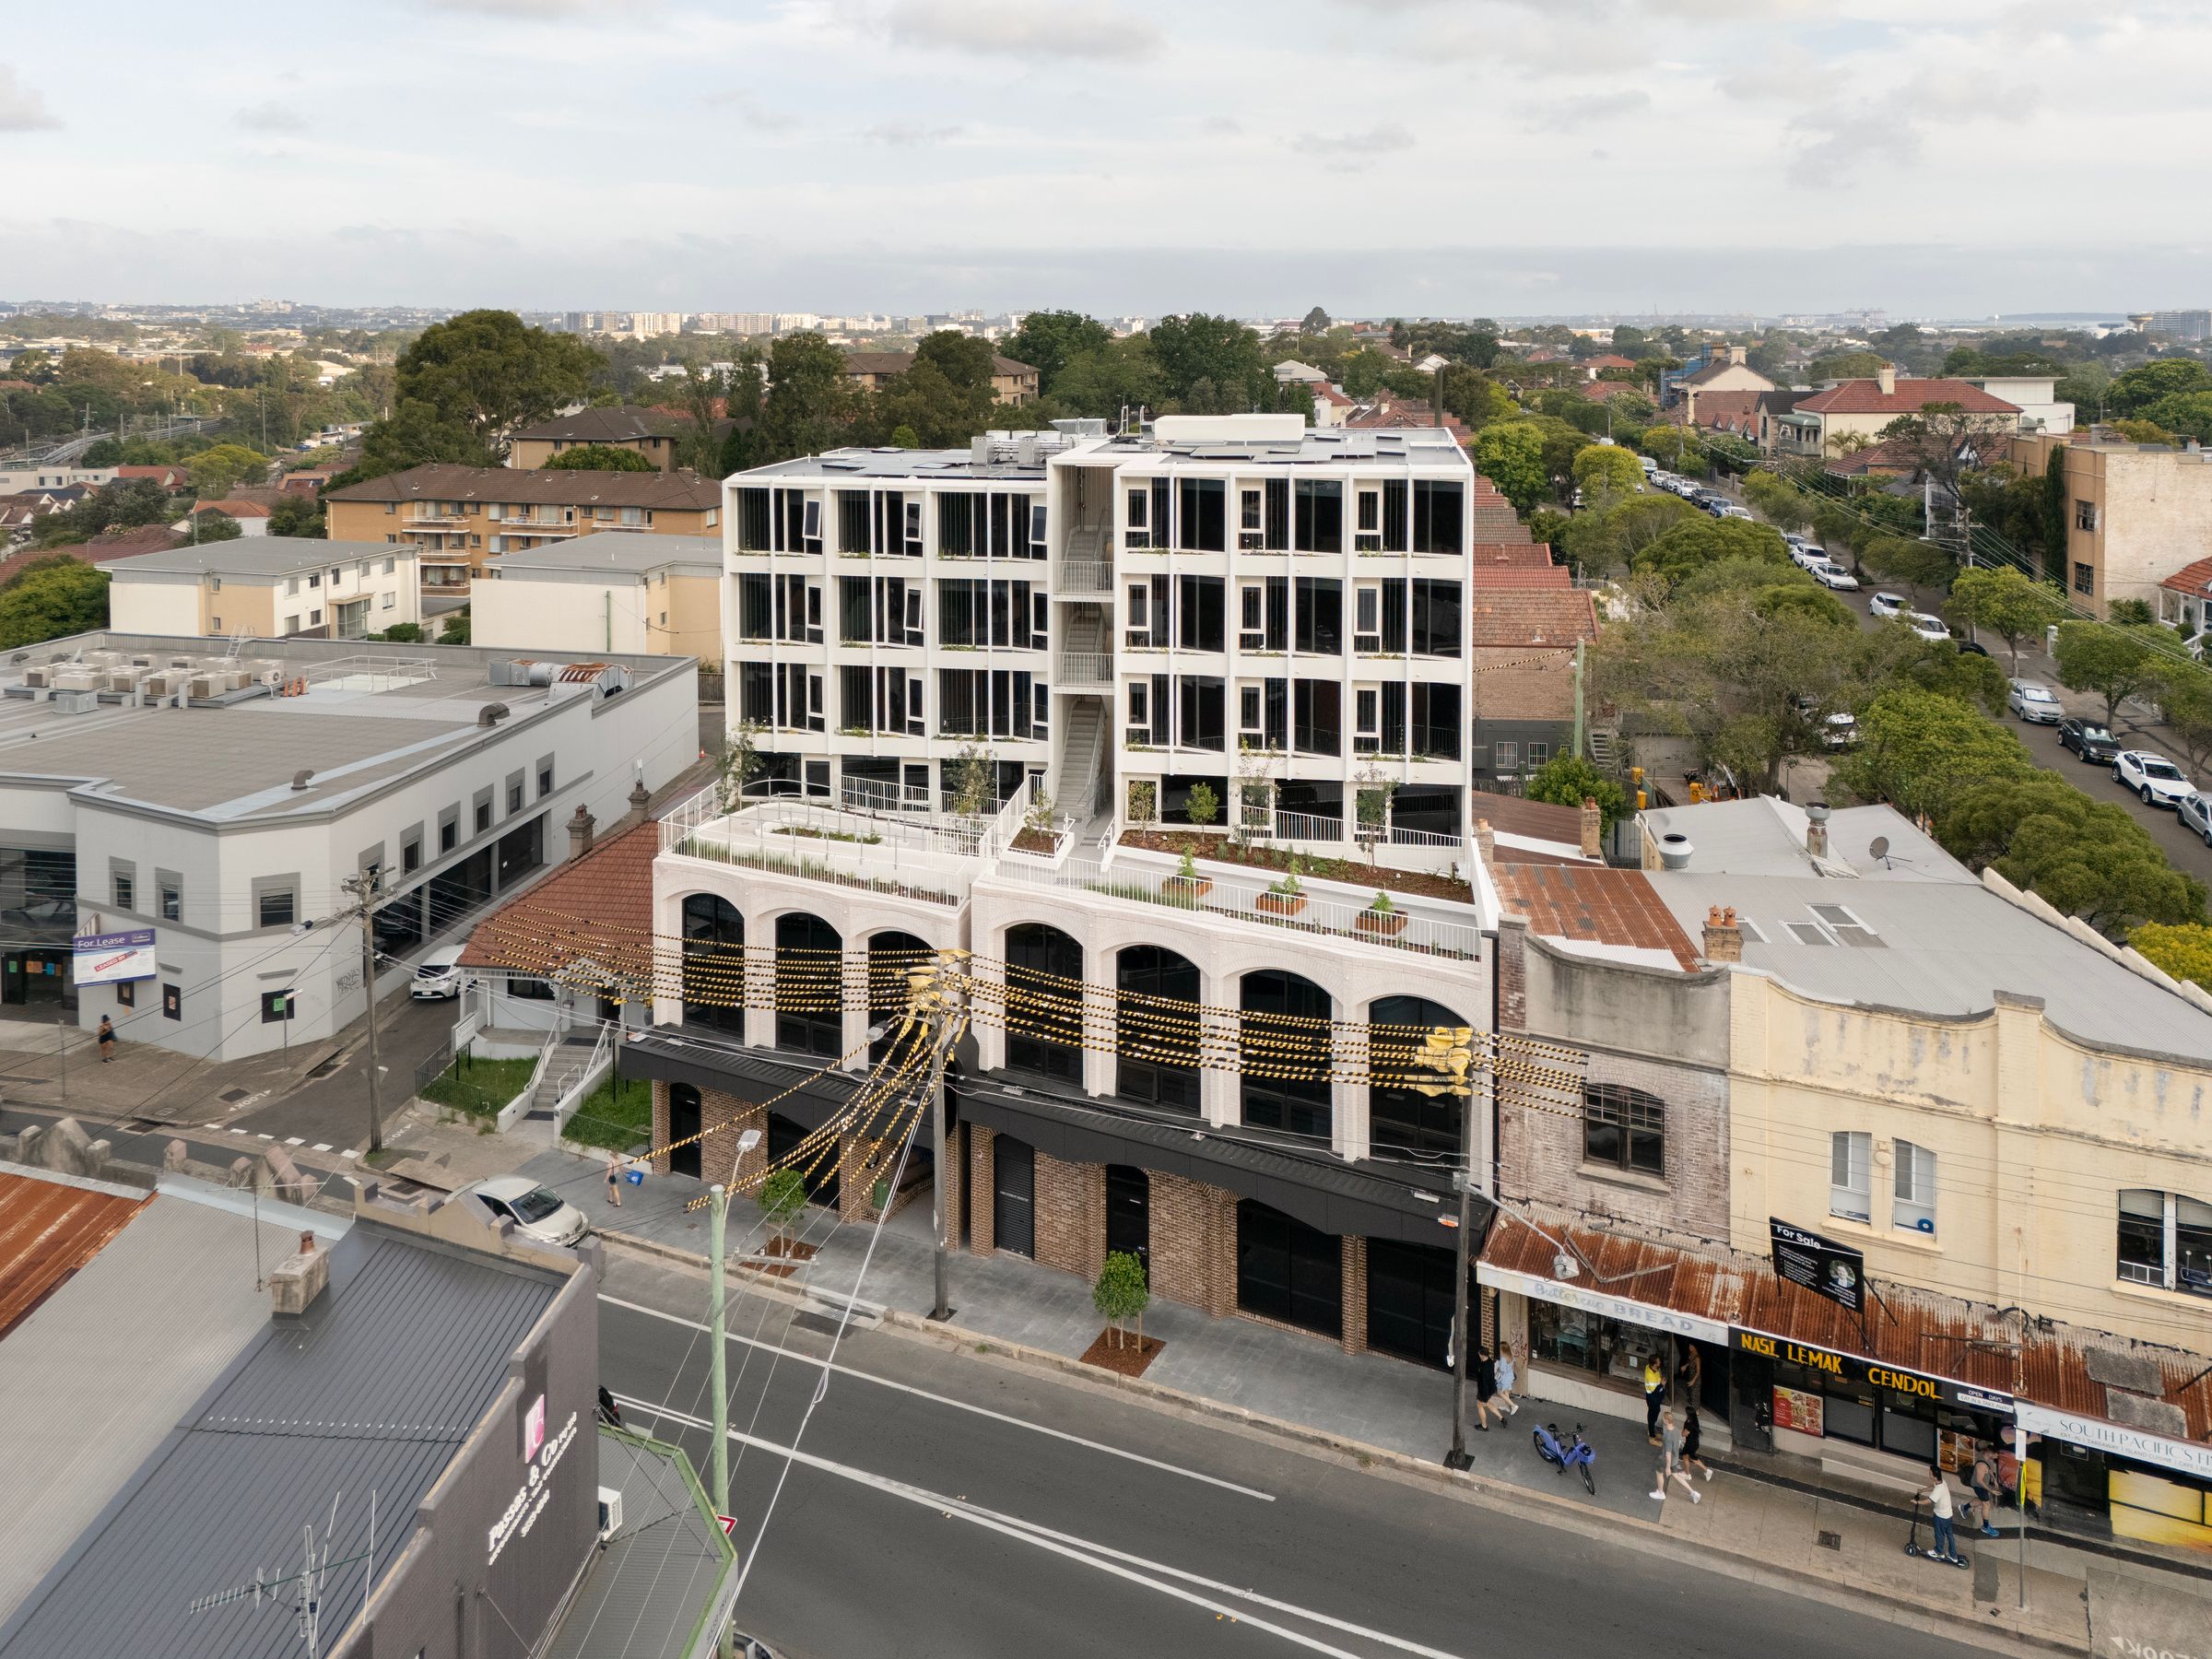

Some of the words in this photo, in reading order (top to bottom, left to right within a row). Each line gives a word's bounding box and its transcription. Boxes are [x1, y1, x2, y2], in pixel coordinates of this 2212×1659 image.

[77, 940, 93, 948] For
[97, 936, 125, 947] Lease
[234, 1093, 266, 1110] LOOK
[1777, 1226, 1794, 1238] For
[1796, 1233, 1821, 1249] Sale
[1615, 1303, 1694, 1331] BREAD
[1741, 1334, 1780, 1358] NASI
[1788, 1345, 1841, 1374] LEMAK
[1868, 1367, 1944, 1399] CENDOL
[1969, 1390, 1983, 1398] OPEN
[1988, 1394, 2003, 1403] DAYS
[2060, 1418, 2114, 1442] SOUTH
[2120, 1433, 2193, 1461] PACIFIC'S
[2124, 1638, 2191, 1659] OOK
